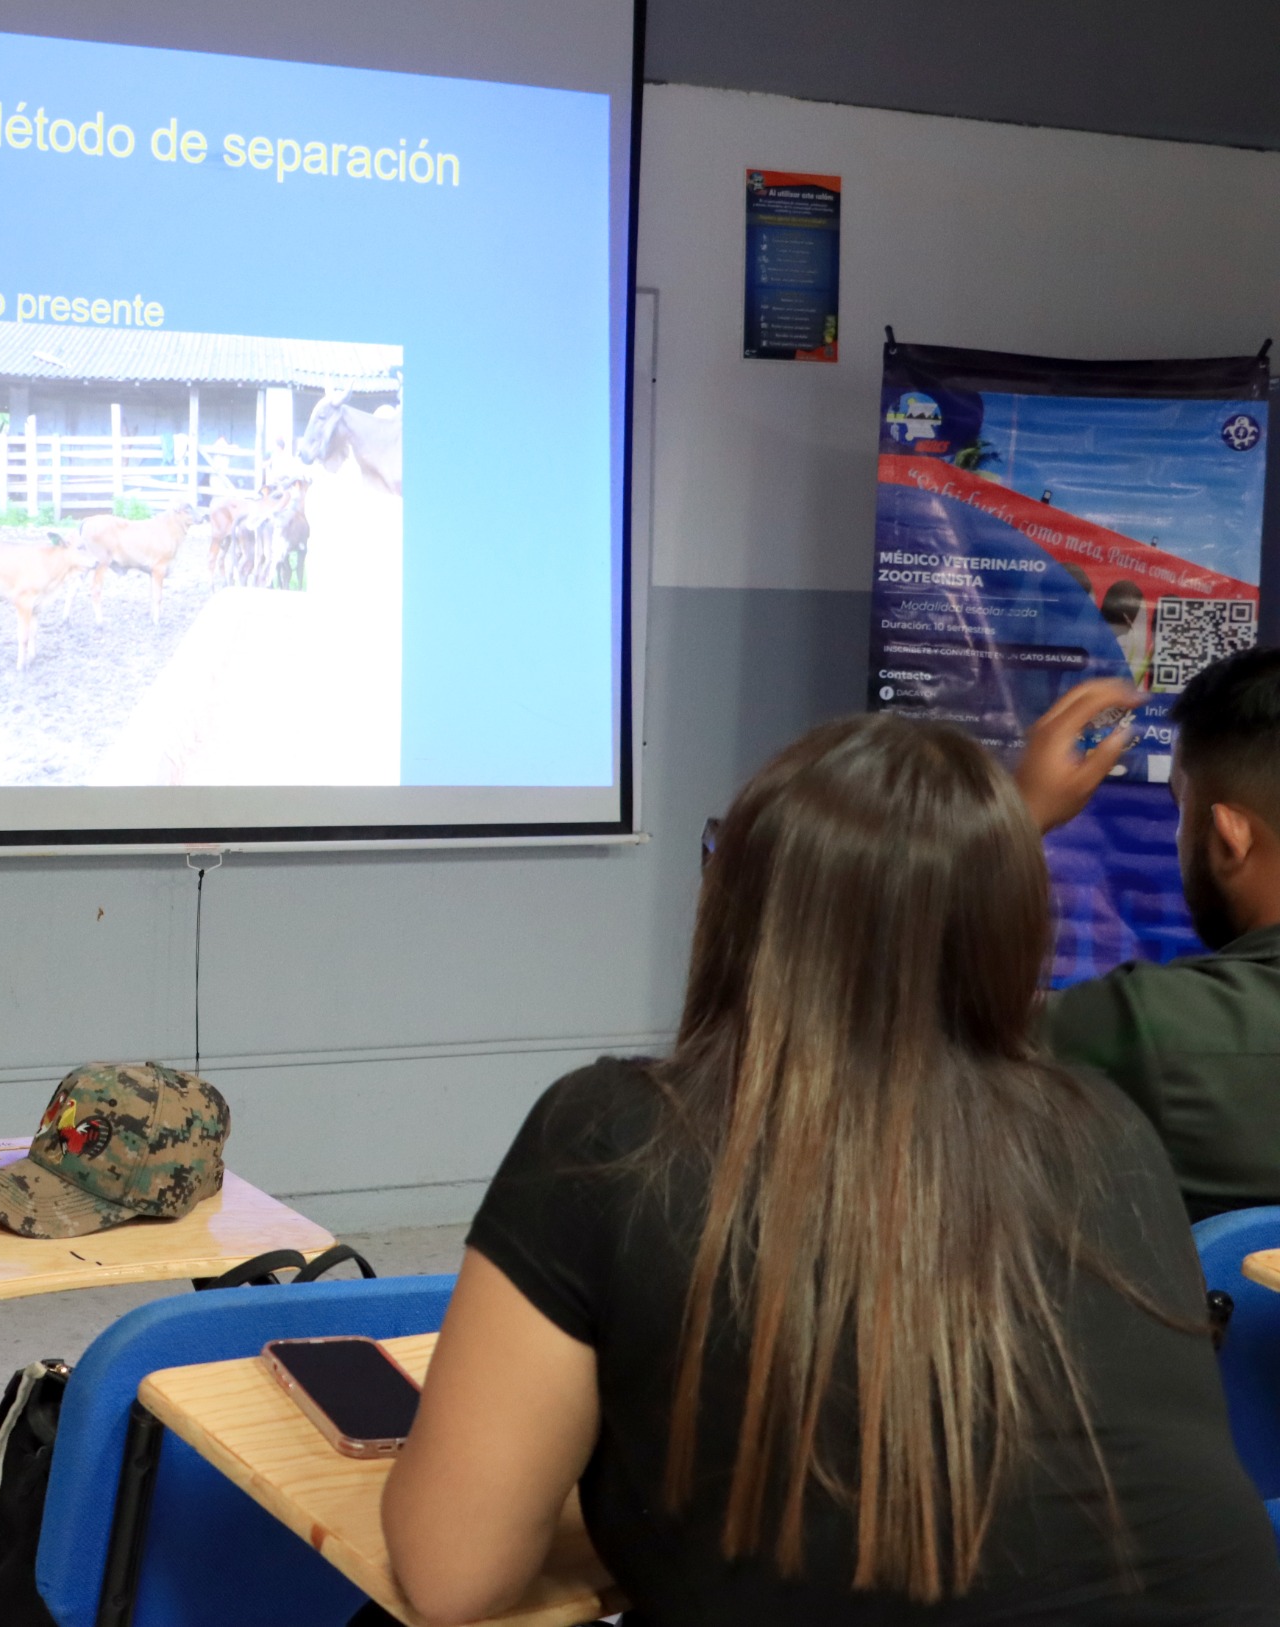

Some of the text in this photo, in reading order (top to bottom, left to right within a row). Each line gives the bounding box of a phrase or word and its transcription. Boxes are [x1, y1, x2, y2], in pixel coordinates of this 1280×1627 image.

[150, 117, 208, 166] de
[222, 131, 462, 188] separación
[16, 289, 166, 329] presente
[879, 550, 1047, 573] MÉDICO VETERINARIO
[1065, 534, 1104, 563] meta,
[1108, 546, 1148, 575] Patria
[878, 569, 984, 588] ZOOTECNISTA
[900, 600, 1039, 618] Modalidad escolarzada
[881, 618, 932, 631] Duración:
[933, 621, 945, 632] 10
[1020, 652, 1044, 663] GATO
[1045, 654, 1084, 664] SALVAJE
[878, 669, 932, 681] Contacto
